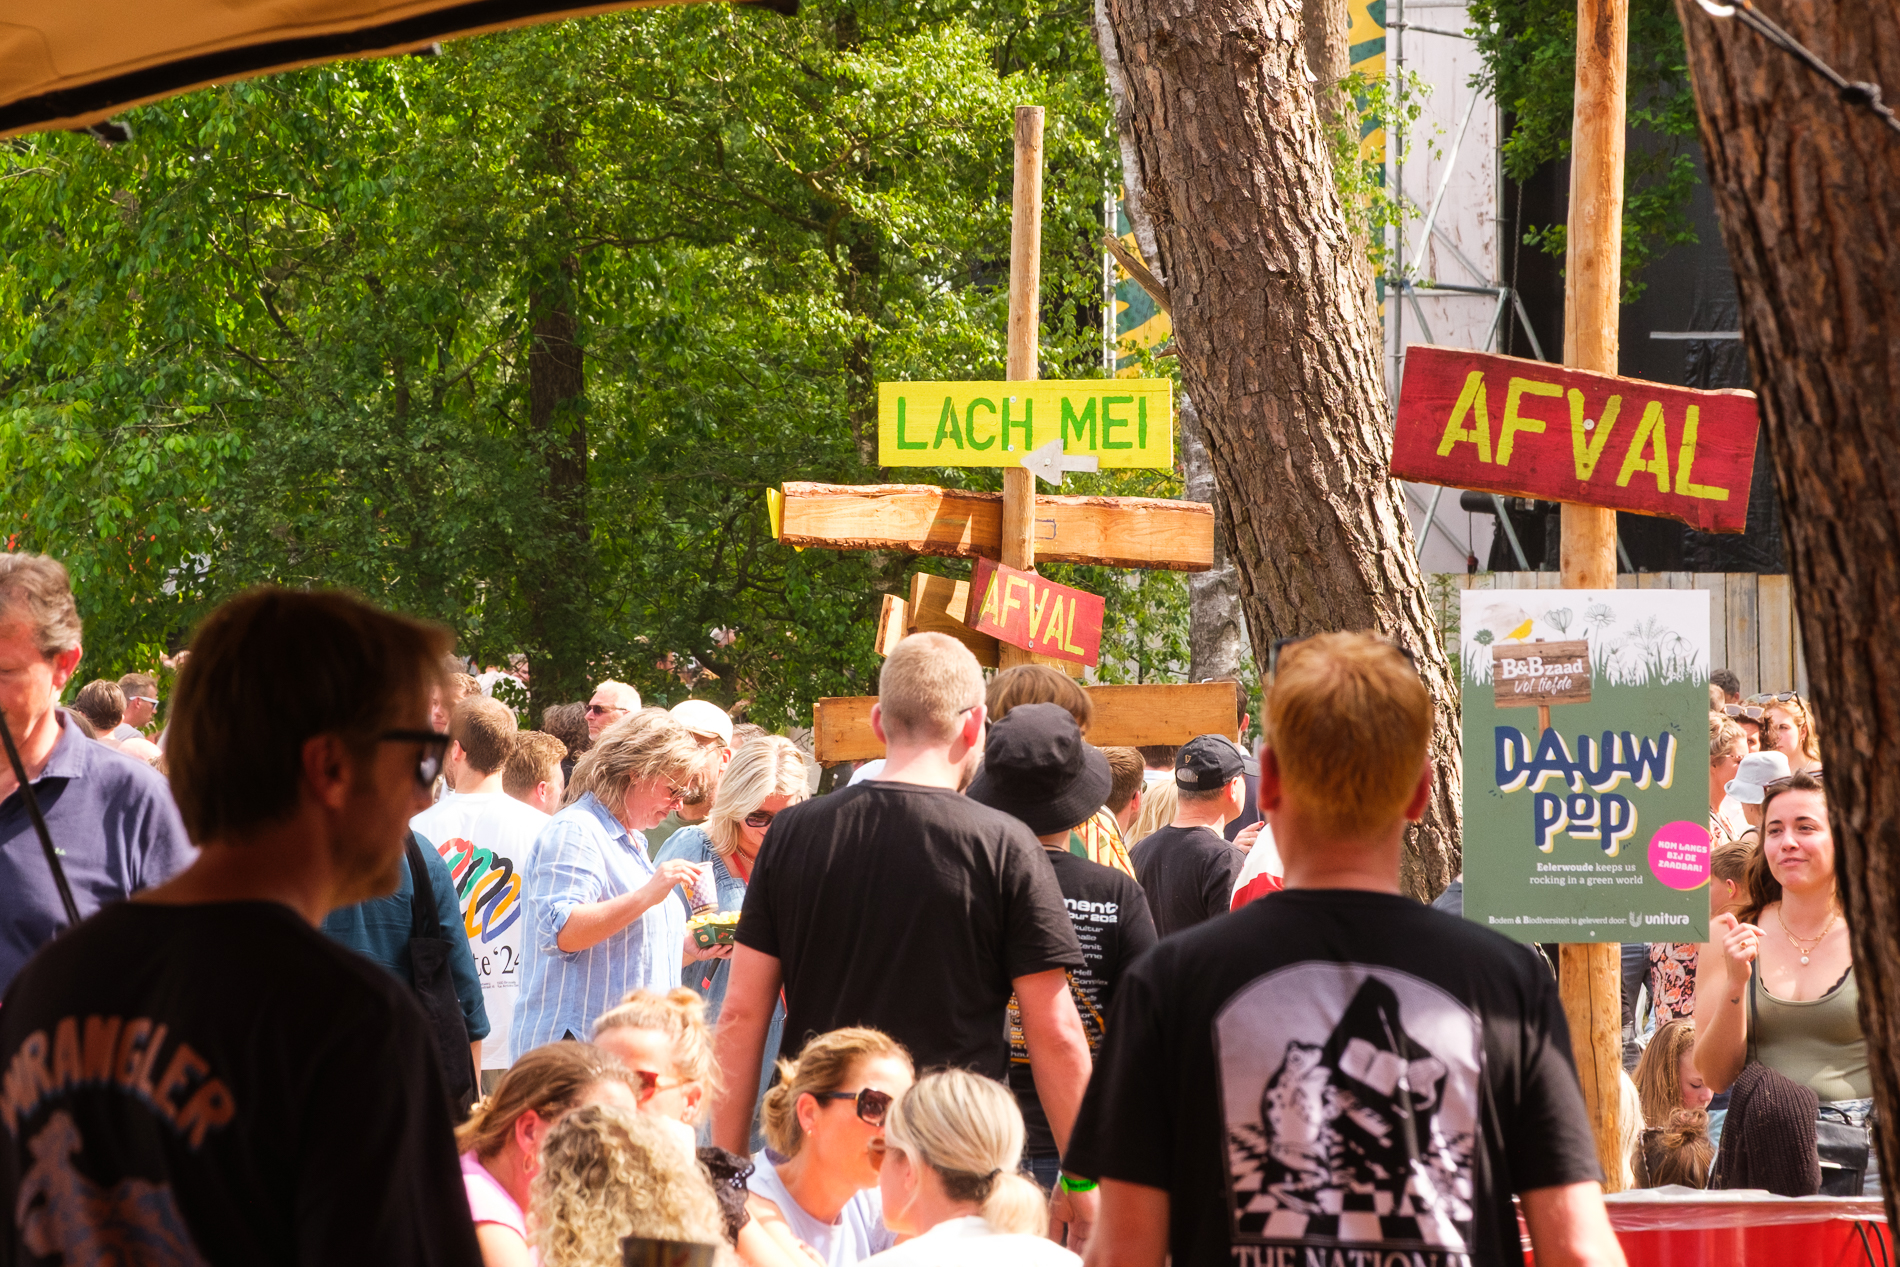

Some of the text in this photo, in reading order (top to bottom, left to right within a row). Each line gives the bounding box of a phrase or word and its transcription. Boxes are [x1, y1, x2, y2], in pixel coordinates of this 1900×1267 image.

[897, 394, 1147, 451] LACH MEI
[1437, 370, 1729, 501] AFVAL
[978, 569, 1085, 656] AFVAL
[1538, 676, 1572, 695] liefde
[1495, 726, 1677, 794] DAUW
[1658, 841, 1708, 853] KOM LANGS
[1667, 851, 1696, 862] BIJ DE
[1536, 862, 1636, 873] Eelerwoude keeps us
[1658, 860, 1702, 872] ZAADBAR!
[1529, 875, 1565, 886] rocking
[1568, 875, 1577, 884] in
[1587, 877, 1613, 886] green
[1616, 875, 1643, 884] world
[1488, 915, 1514, 924] Bodem
[1515, 916, 1522, 924] &
[1523, 915, 1570, 925] Biodiversiteit
[1571, 916, 1577, 924] is
[1578, 916, 1607, 926] geleverd
[1645, 912, 1690, 925] unitura
